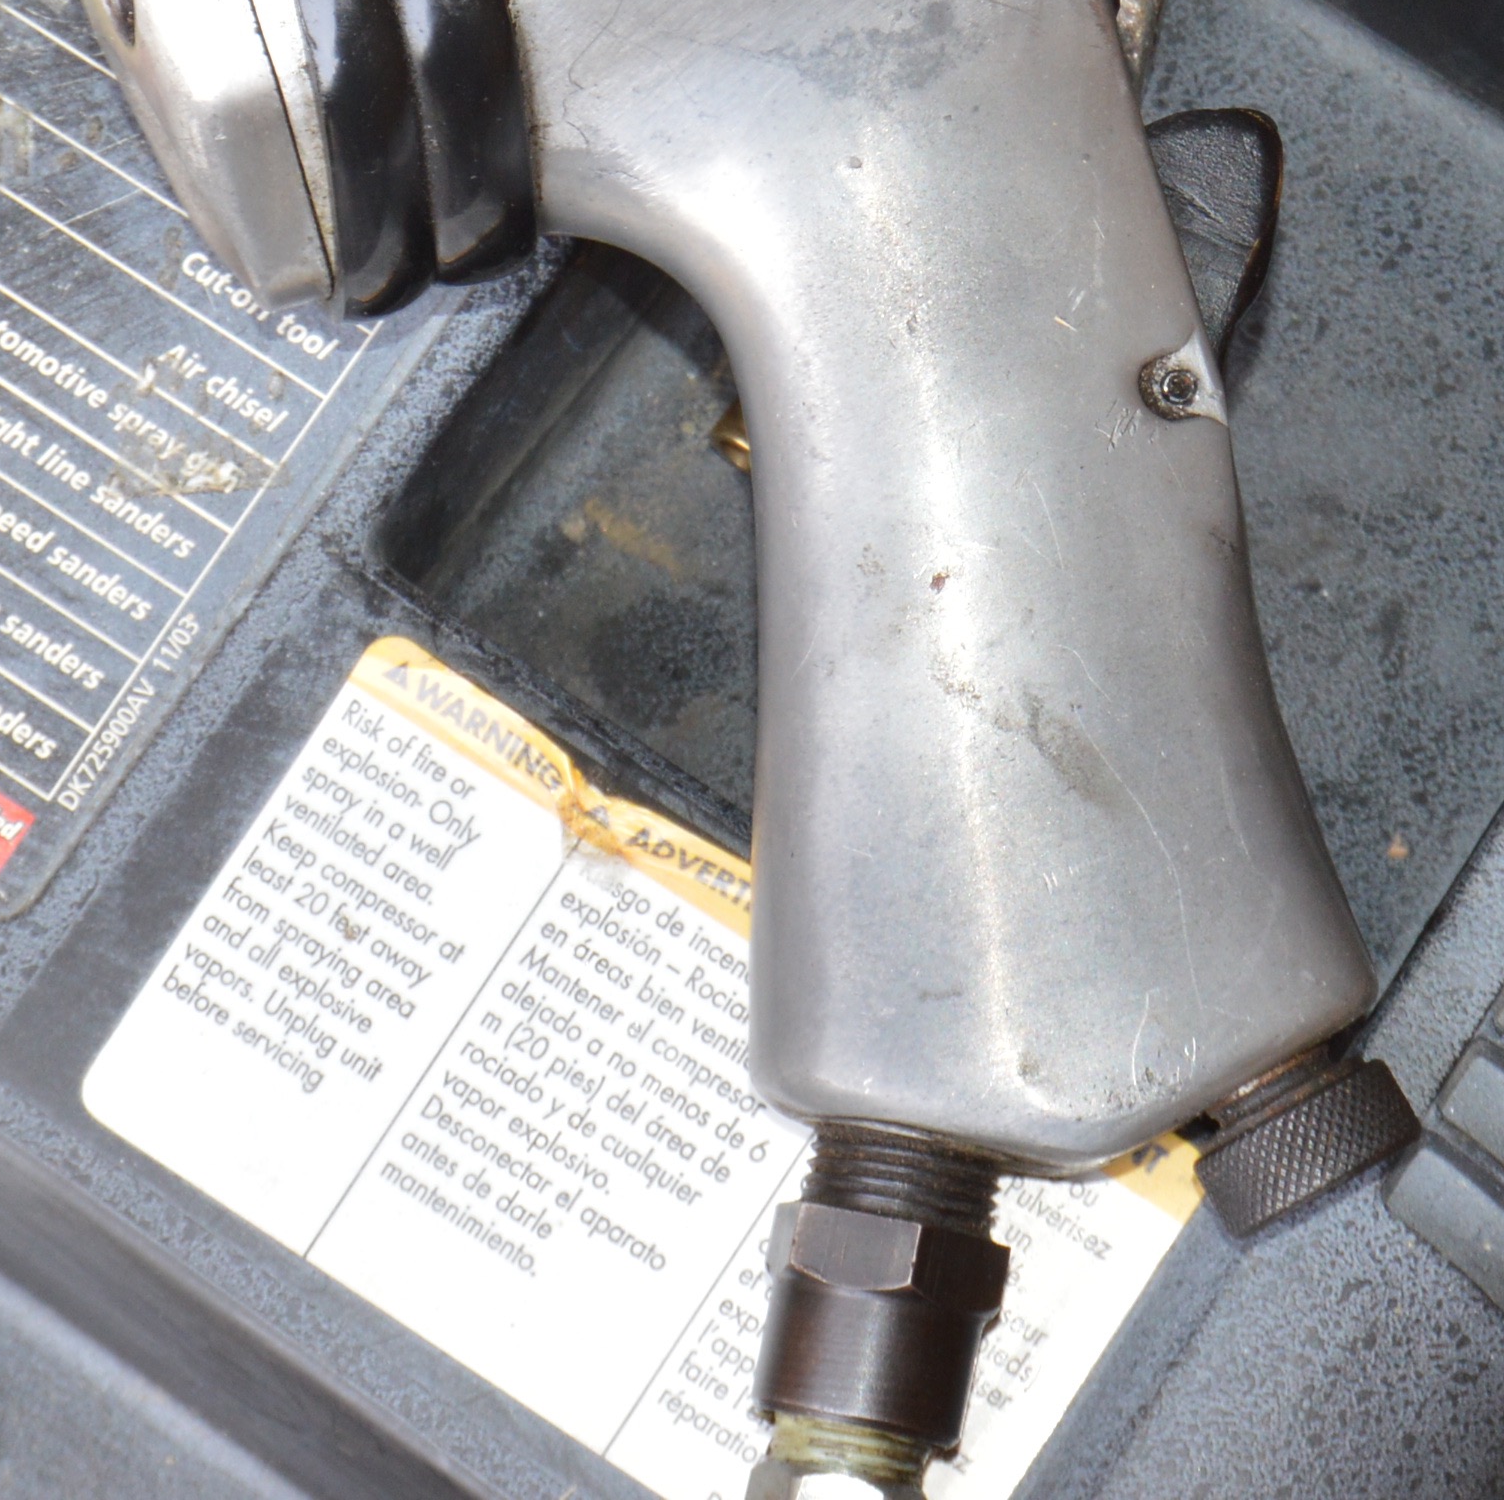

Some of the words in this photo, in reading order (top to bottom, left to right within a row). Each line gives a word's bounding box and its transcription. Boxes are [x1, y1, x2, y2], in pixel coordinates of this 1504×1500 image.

[157, 344, 206, 379] Air
[206, 376, 288, 432] chisel
[277, 306, 340, 360] tool
[107, 403, 184, 459] spray
[36, 443, 90, 490] line
[90, 485, 194, 557] sanders
[47, 546, 151, 619] sanders
[0, 615, 104, 688] sanders
[58, 677, 154, 810] DK725900AV
[152, 615, 199, 670] 11/03
[341, 698, 385, 743] Risk
[386, 736, 417, 759] of
[411, 745, 447, 783] fire
[449, 777, 476, 800] or
[416, 676, 565, 793] WARNING
[301, 766, 363, 816] spray
[362, 799, 385, 828] in
[387, 822, 406, 841] a
[409, 833, 459, 871] well
[322, 737, 423, 808] explosion-
[428, 799, 481, 849] Only
[256, 817, 317, 871] Keep
[320, 863, 438, 945] compressor
[438, 940, 466, 964] at
[285, 795, 387, 867] ventilated
[382, 861, 433, 906] area.
[626, 828, 751, 913] ADVERT
[222, 875, 271, 924] from
[273, 918, 363, 989] spraying
[365, 979, 416, 1020] area
[242, 845, 298, 894] least
[292, 881, 330, 916] 20
[328, 902, 371, 944] feet
[369, 938, 432, 989] away
[540, 921, 569, 948] en
[573, 937, 633, 990] áreas
[636, 974, 685, 1025] bien
[560, 891, 662, 966] explosión
[654, 905, 685, 938] de
[162, 964, 230, 1026] before
[232, 1020, 325, 1094] servicing
[184, 942, 253, 1002] vapors.
[263, 988, 338, 1059] Unplug
[340, 1047, 383, 1082] unit
[202, 914, 253, 950] and
[247, 942, 282, 970] all
[277, 964, 373, 1034] explosive
[500, 981, 582, 1042] alejado
[586, 1038, 604, 1057] a
[606, 1051, 637, 1078] no
[640, 1073, 711, 1127] menos
[714, 1116, 745, 1150] de
[748, 1139, 770, 1163] 6
[518, 945, 624, 1024] Mantener
[626, 1018, 656, 1044] el
[651, 1037, 769, 1117] compresor
[442, 1070, 506, 1119] vapor
[507, 1116, 609, 1195] explosivo.
[460, 1041, 544, 1103] rociado
[541, 1096, 566, 1120] y
[566, 1107, 597, 1138] de
[600, 1134, 702, 1206] cualquier
[479, 1011, 503, 1034] m
[503, 1020, 550, 1061] (20
[543, 1056, 606, 1104] pies)
[605, 1089, 648, 1125] del
[644, 1114, 697, 1161] área
[699, 1150, 731, 1183] de
[380, 1161, 535, 1276] mantenimiento.
[400, 1132, 458, 1177] antes
[461, 1167, 492, 1200] de
[495, 1190, 553, 1239] darle
[420, 1093, 552, 1193] Desconectar
[554, 1187, 584, 1213] el
[579, 1206, 666, 1271] aparato
[1004, 1224, 1033, 1253] un
[678, 1350, 730, 1401] faire
